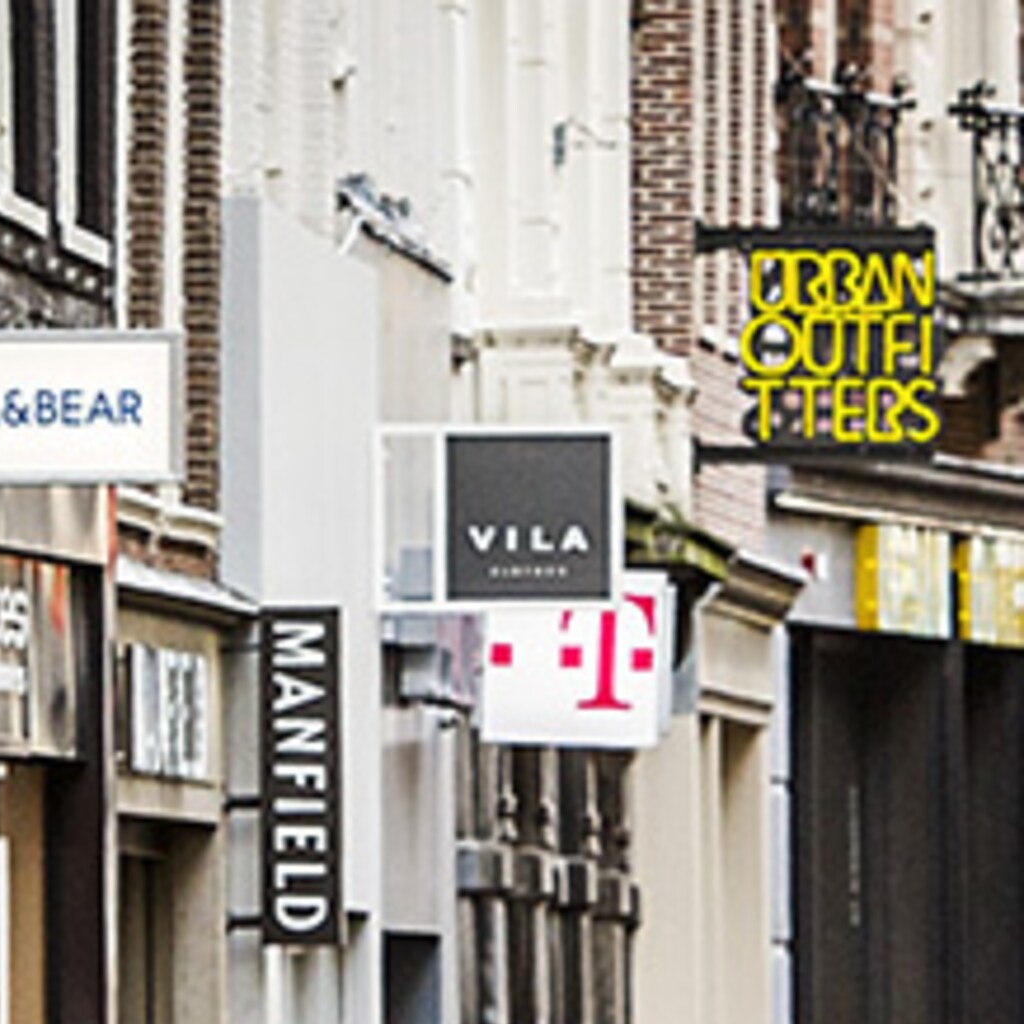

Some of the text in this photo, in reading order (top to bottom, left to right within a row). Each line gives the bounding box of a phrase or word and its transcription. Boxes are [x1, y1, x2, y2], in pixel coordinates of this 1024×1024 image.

[750, 249, 936, 315] URBAN
[739, 313, 933, 378] OUTFI
[742, 376, 941, 443] TTERS
[467, 524, 589, 551] VILA
[272, 619, 328, 933] MANFIELD
